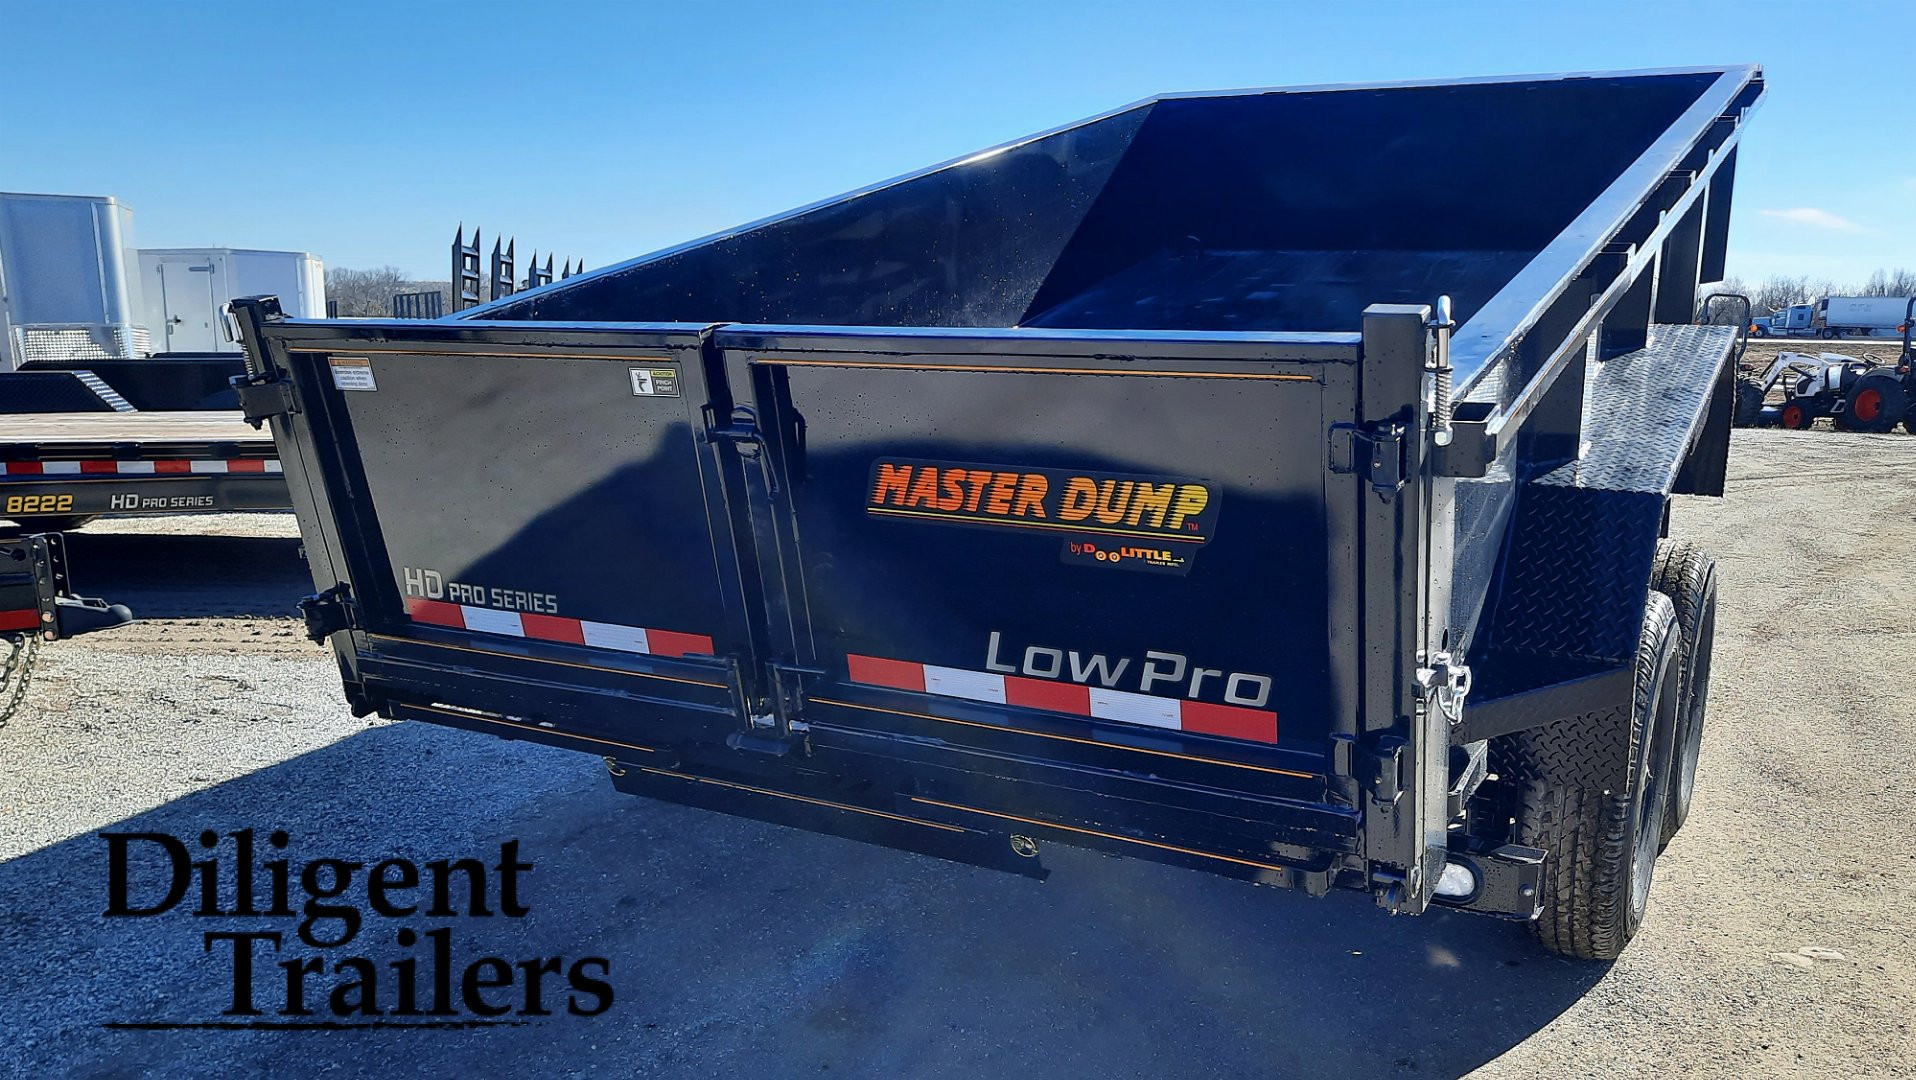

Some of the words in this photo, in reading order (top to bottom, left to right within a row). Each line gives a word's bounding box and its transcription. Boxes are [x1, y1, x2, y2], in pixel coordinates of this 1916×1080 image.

[6, 494, 74, 513] 8222
[111, 494, 139, 510] HD
[142, 498, 167, 508] PRO
[170, 495, 214, 508] SERIES
[870, 463, 1049, 519] MASTER
[1055, 476, 1209, 529] DUMP
[1070, 541, 1081, 555] by
[402, 567, 444, 599] HD
[448, 582, 486, 606] PRO
[491, 588, 557, 614] SERIES
